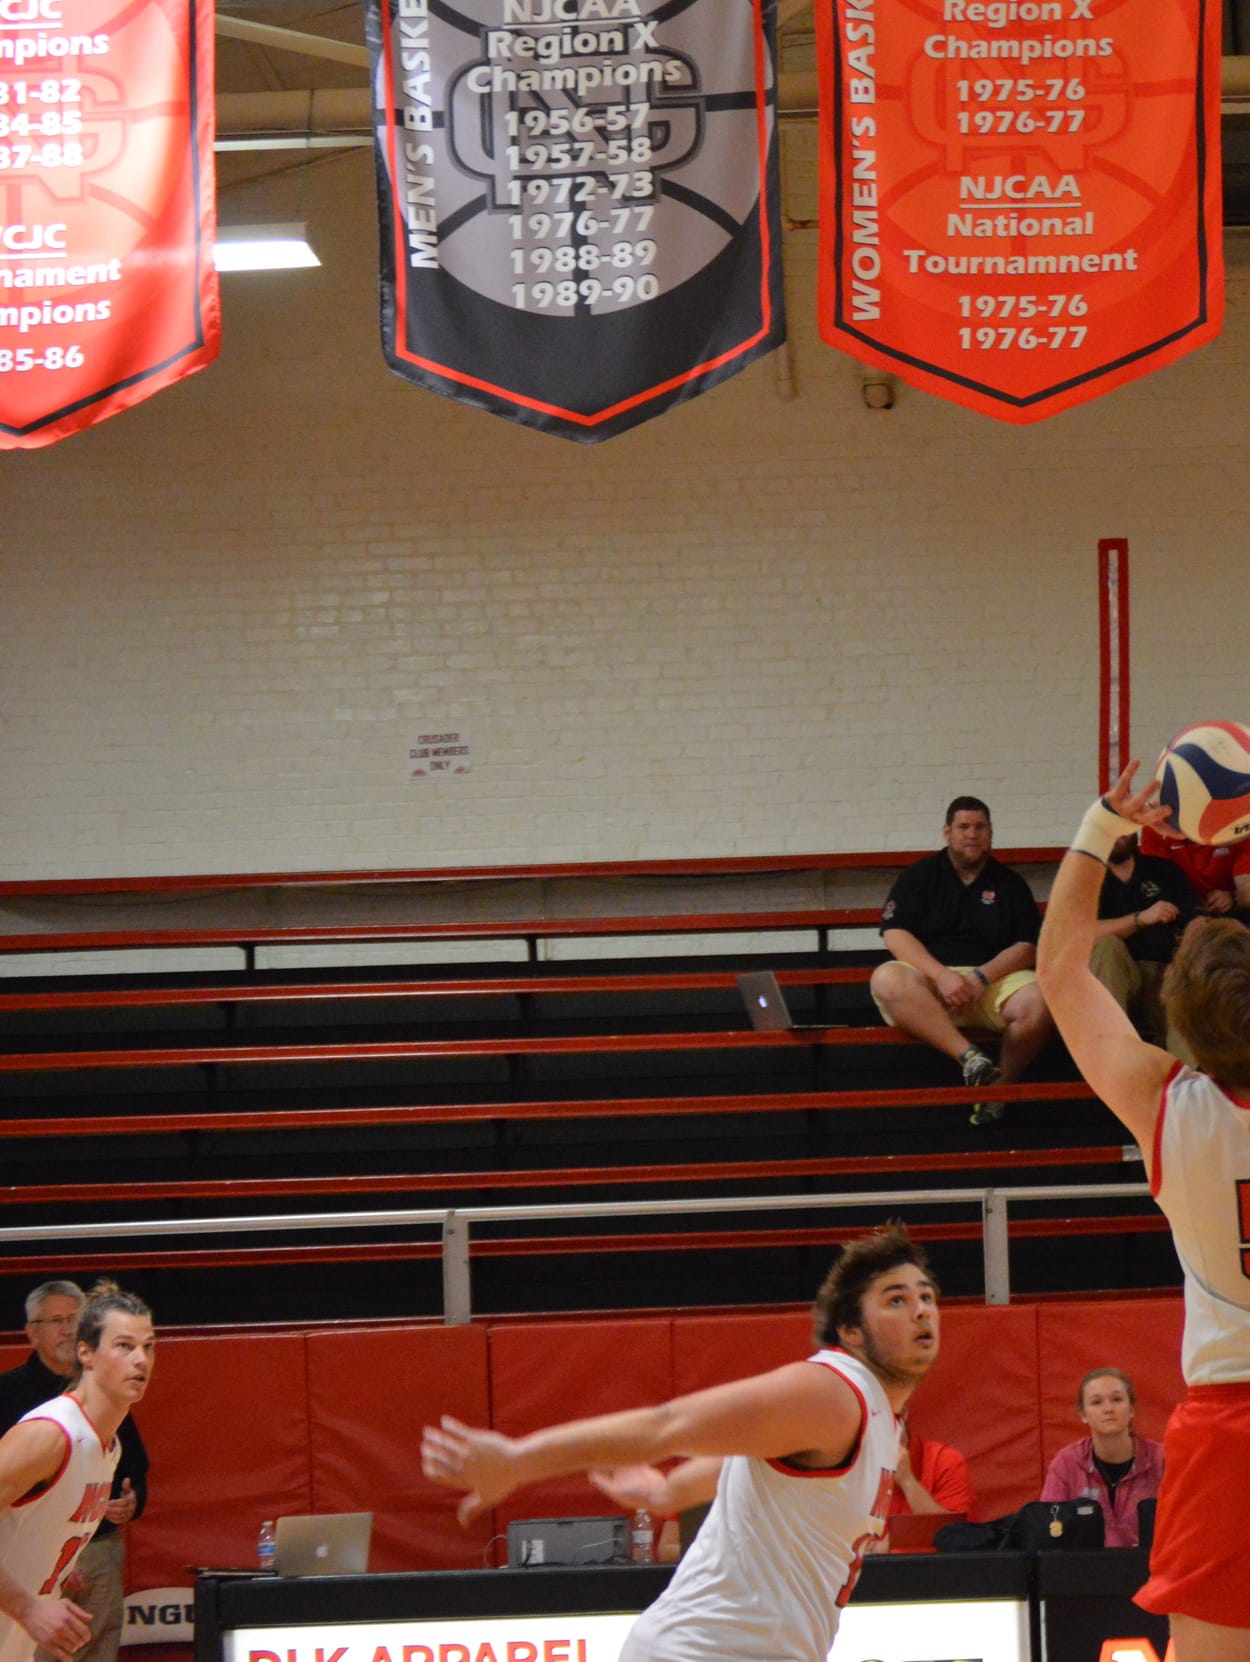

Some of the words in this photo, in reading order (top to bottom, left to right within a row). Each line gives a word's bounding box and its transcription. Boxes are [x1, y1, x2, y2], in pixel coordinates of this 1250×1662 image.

[503, 0, 642, 23] NJCAA
[943, 0, 1062, 28] Region
[1069, 0, 1094, 19] X
[487, 26, 625, 64] Region
[631, 20, 660, 49] X
[924, 34, 1113, 65] Champions
[466, 59, 682, 97] Champions
[956, 79, 1086, 102] 1975-76
[504, 103, 651, 137] 1956-57
[956, 109, 1086, 134] 1976-77
[505, 137, 653, 171] 1957-58
[507, 170, 654, 205] 1972-73
[959, 174, 1081, 199] NJCAA
[406, 142, 440, 270] MEN'S
[851, 116, 881, 321] WOMEN'S
[0, 223, 67, 249] CJC
[508, 205, 655, 240] 1976-77
[946, 212, 1094, 237] National
[510, 239, 657, 274] 1988-89
[903, 248, 1138, 275] Tournamnent
[512, 273, 659, 309] 1989-90
[958, 294, 1088, 318] 1975-76
[958, 326, 1088, 350] 1976-77
